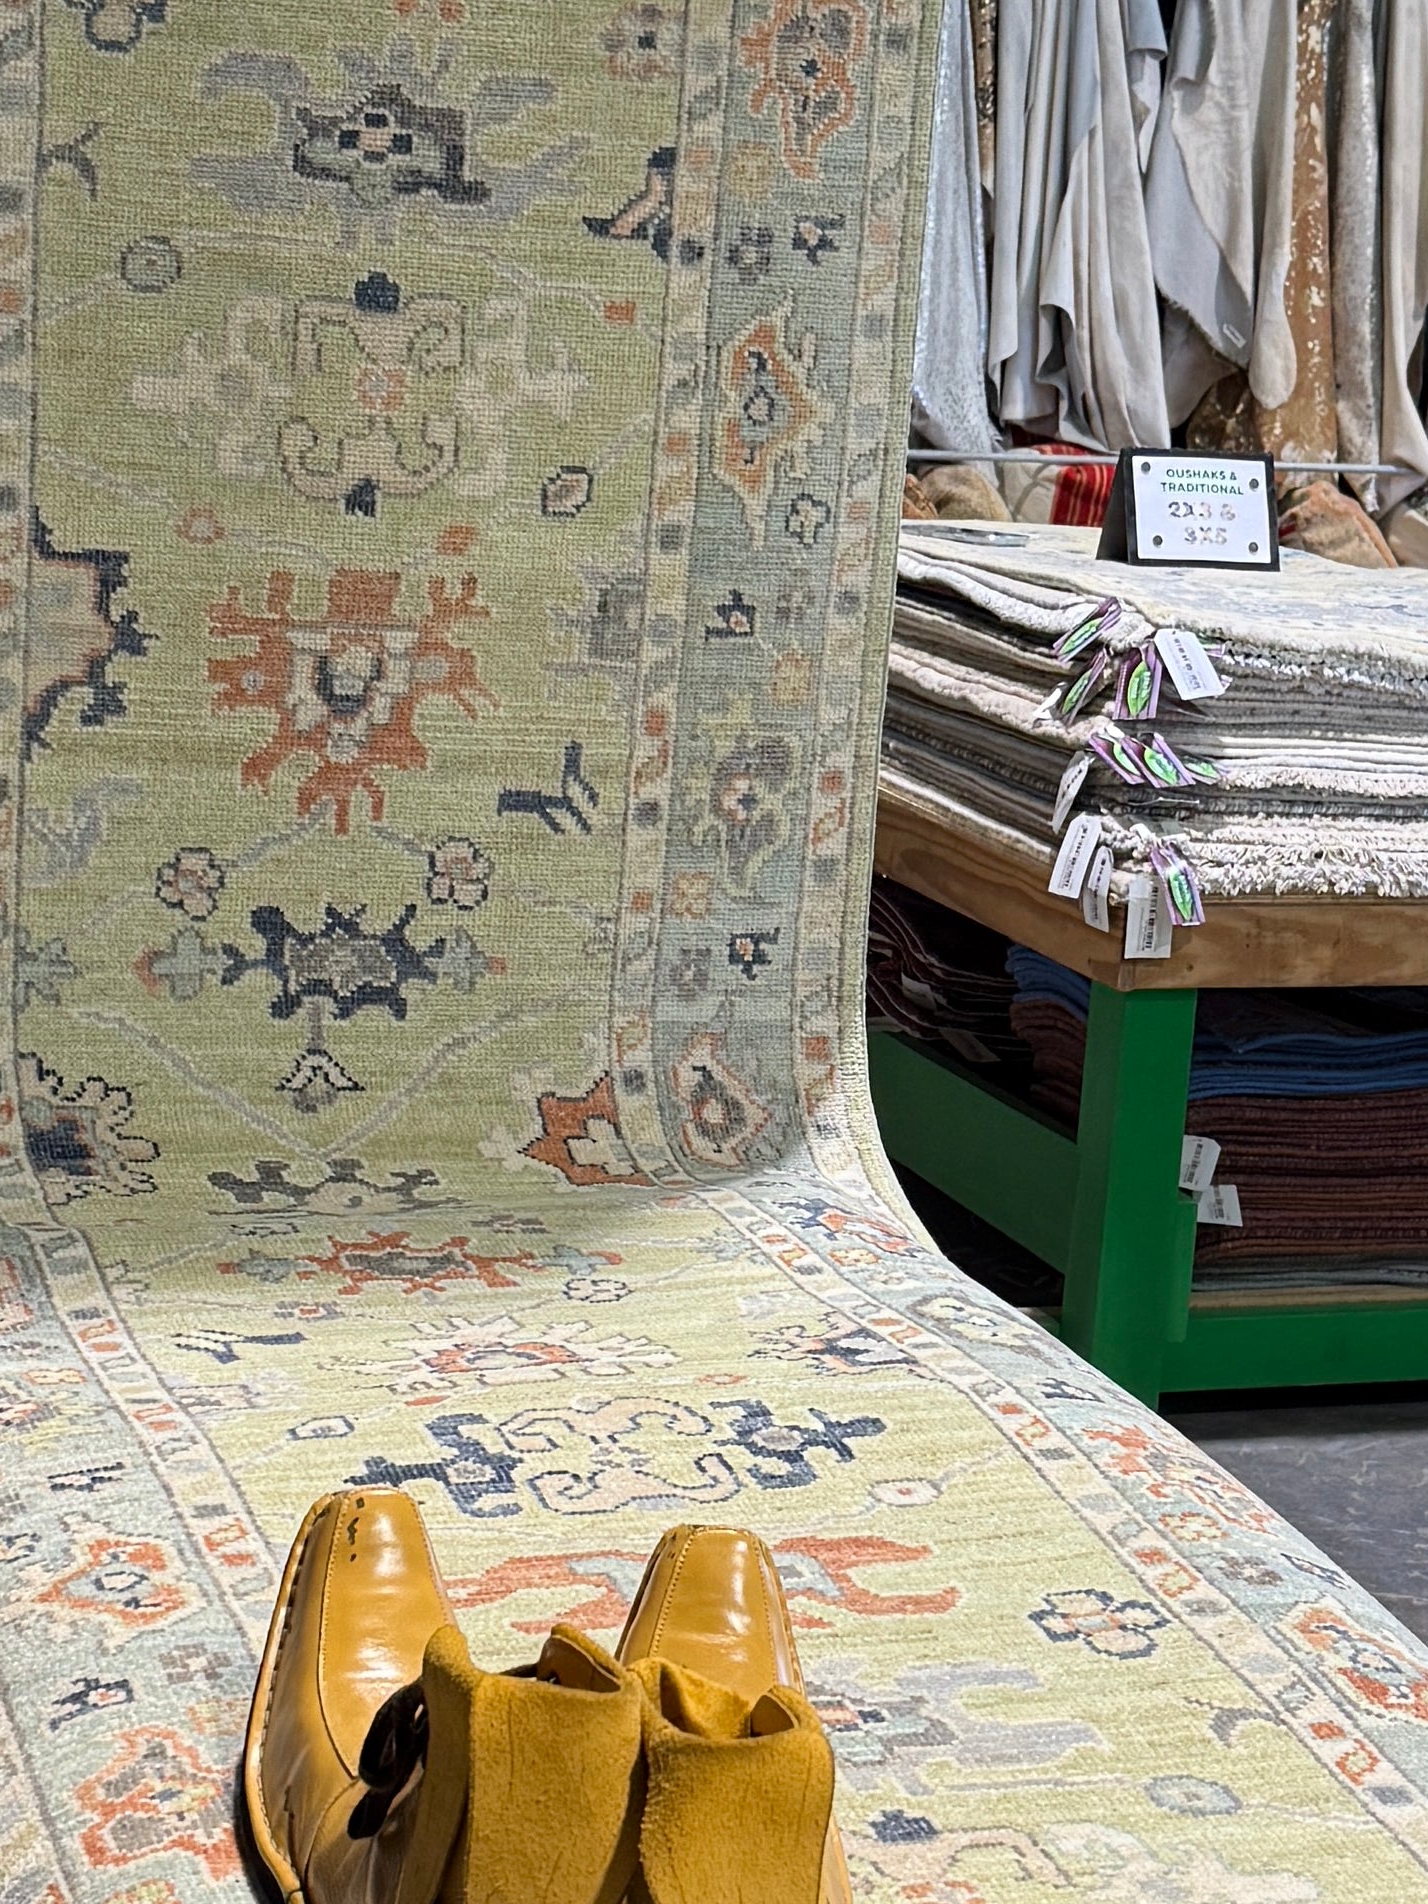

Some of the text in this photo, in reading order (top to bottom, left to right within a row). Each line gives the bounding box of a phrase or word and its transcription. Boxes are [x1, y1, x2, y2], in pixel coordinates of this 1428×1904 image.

[1166, 468, 1238, 481] OUSHAKS &
[1160, 482, 1244, 496] TRADITIONAL
